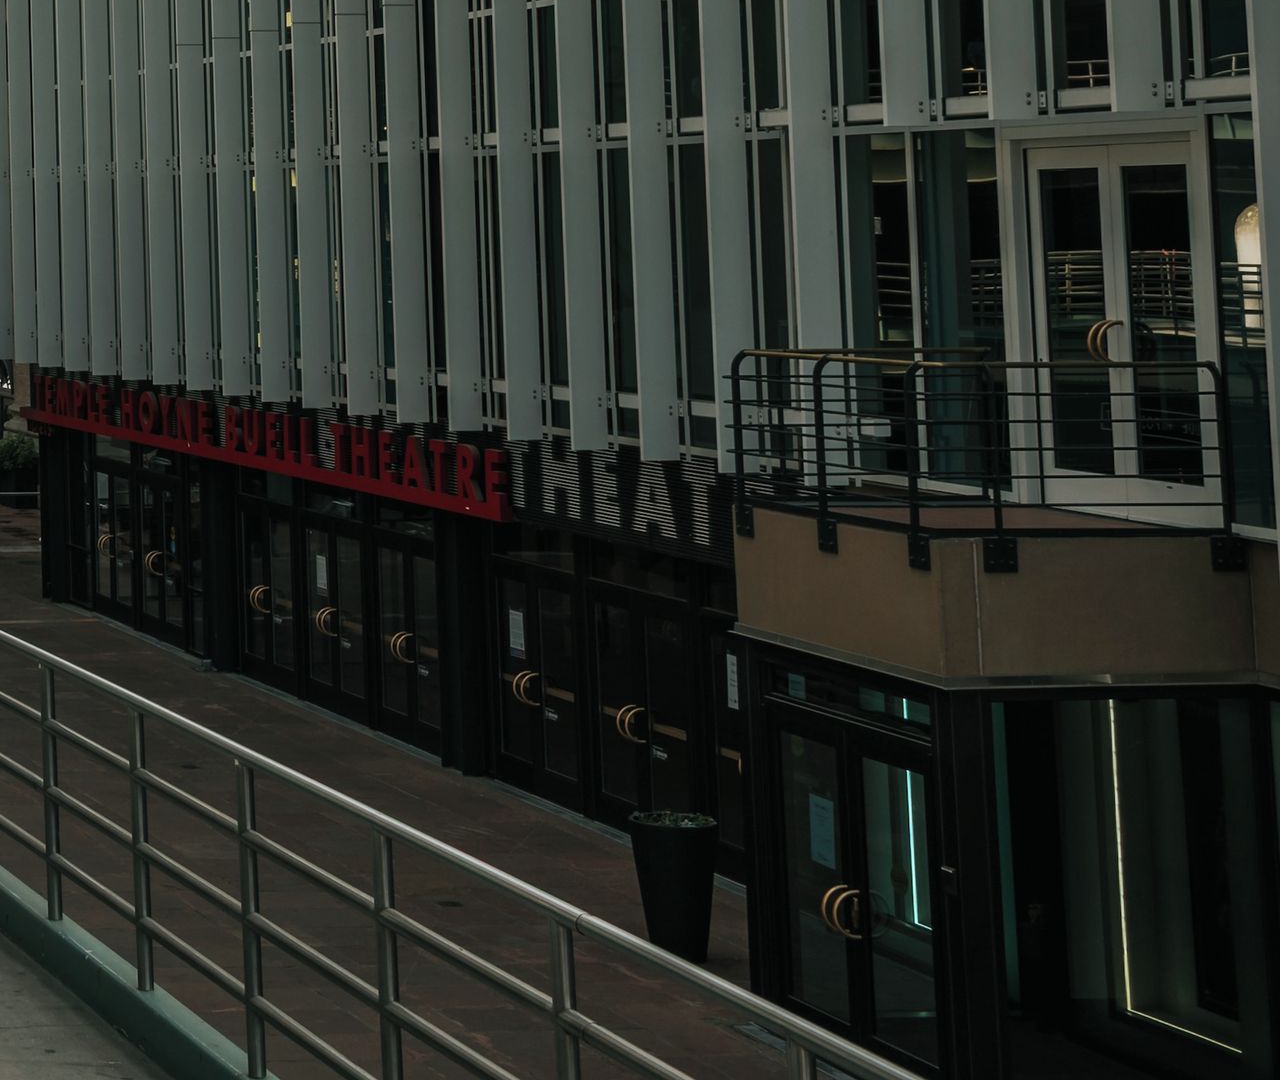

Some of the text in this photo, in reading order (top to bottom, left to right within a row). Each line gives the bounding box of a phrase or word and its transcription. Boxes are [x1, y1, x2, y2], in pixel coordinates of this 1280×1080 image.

[33, 374, 508, 506] TEMPLE HOYNE BUELL THEATRE
